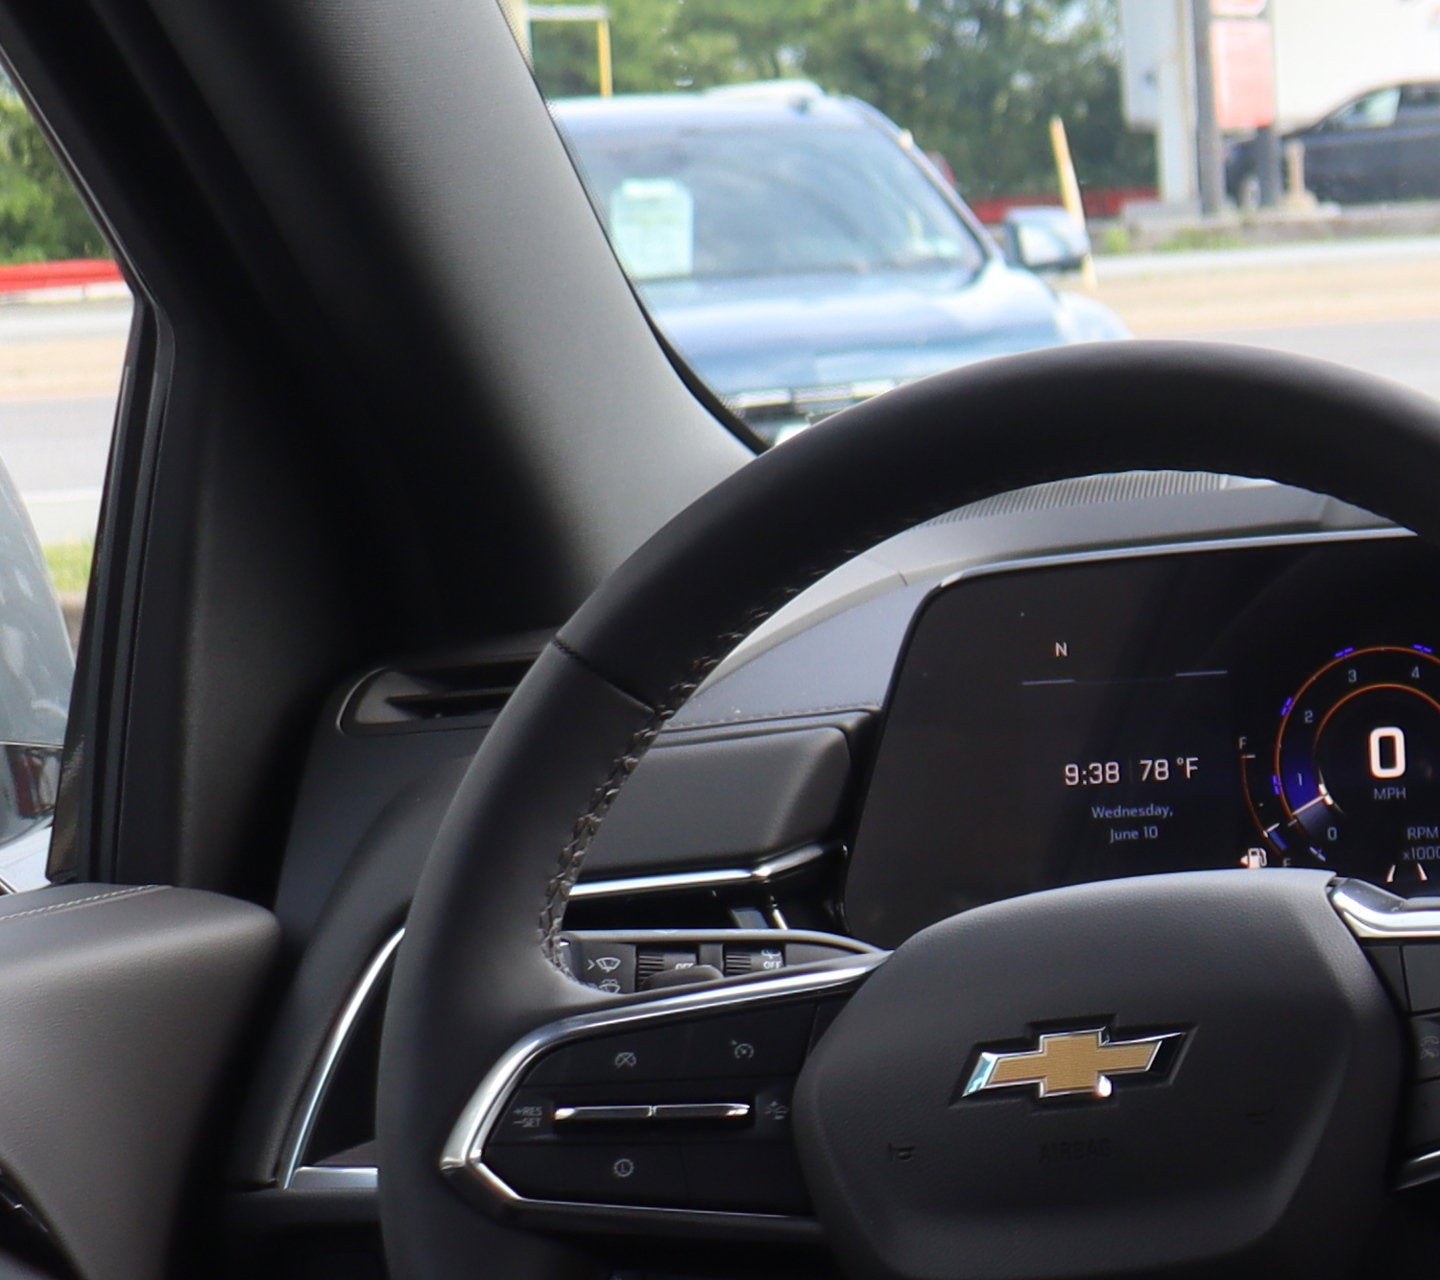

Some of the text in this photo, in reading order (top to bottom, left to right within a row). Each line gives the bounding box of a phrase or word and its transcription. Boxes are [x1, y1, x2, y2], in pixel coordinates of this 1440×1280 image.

[1055, 641, 1068, 657] N
[1348, 669, 1357, 683] 3
[1410, 665, 1421, 680] 4
[1304, 710, 1314, 724] 2
[1238, 736, 1248, 749] F
[1368, 726, 1406, 778] 0
[1064, 756, 1199, 786] 9:38 78 °F
[1373, 786, 1407, 801] MPH
[1090, 802, 1174, 820] Wednesday,
[1108, 824, 1159, 844] June 10
[1327, 826, 1338, 841] 0
[1407, 826, 1439, 841] RPM
[762, 960, 782, 970] OFF
